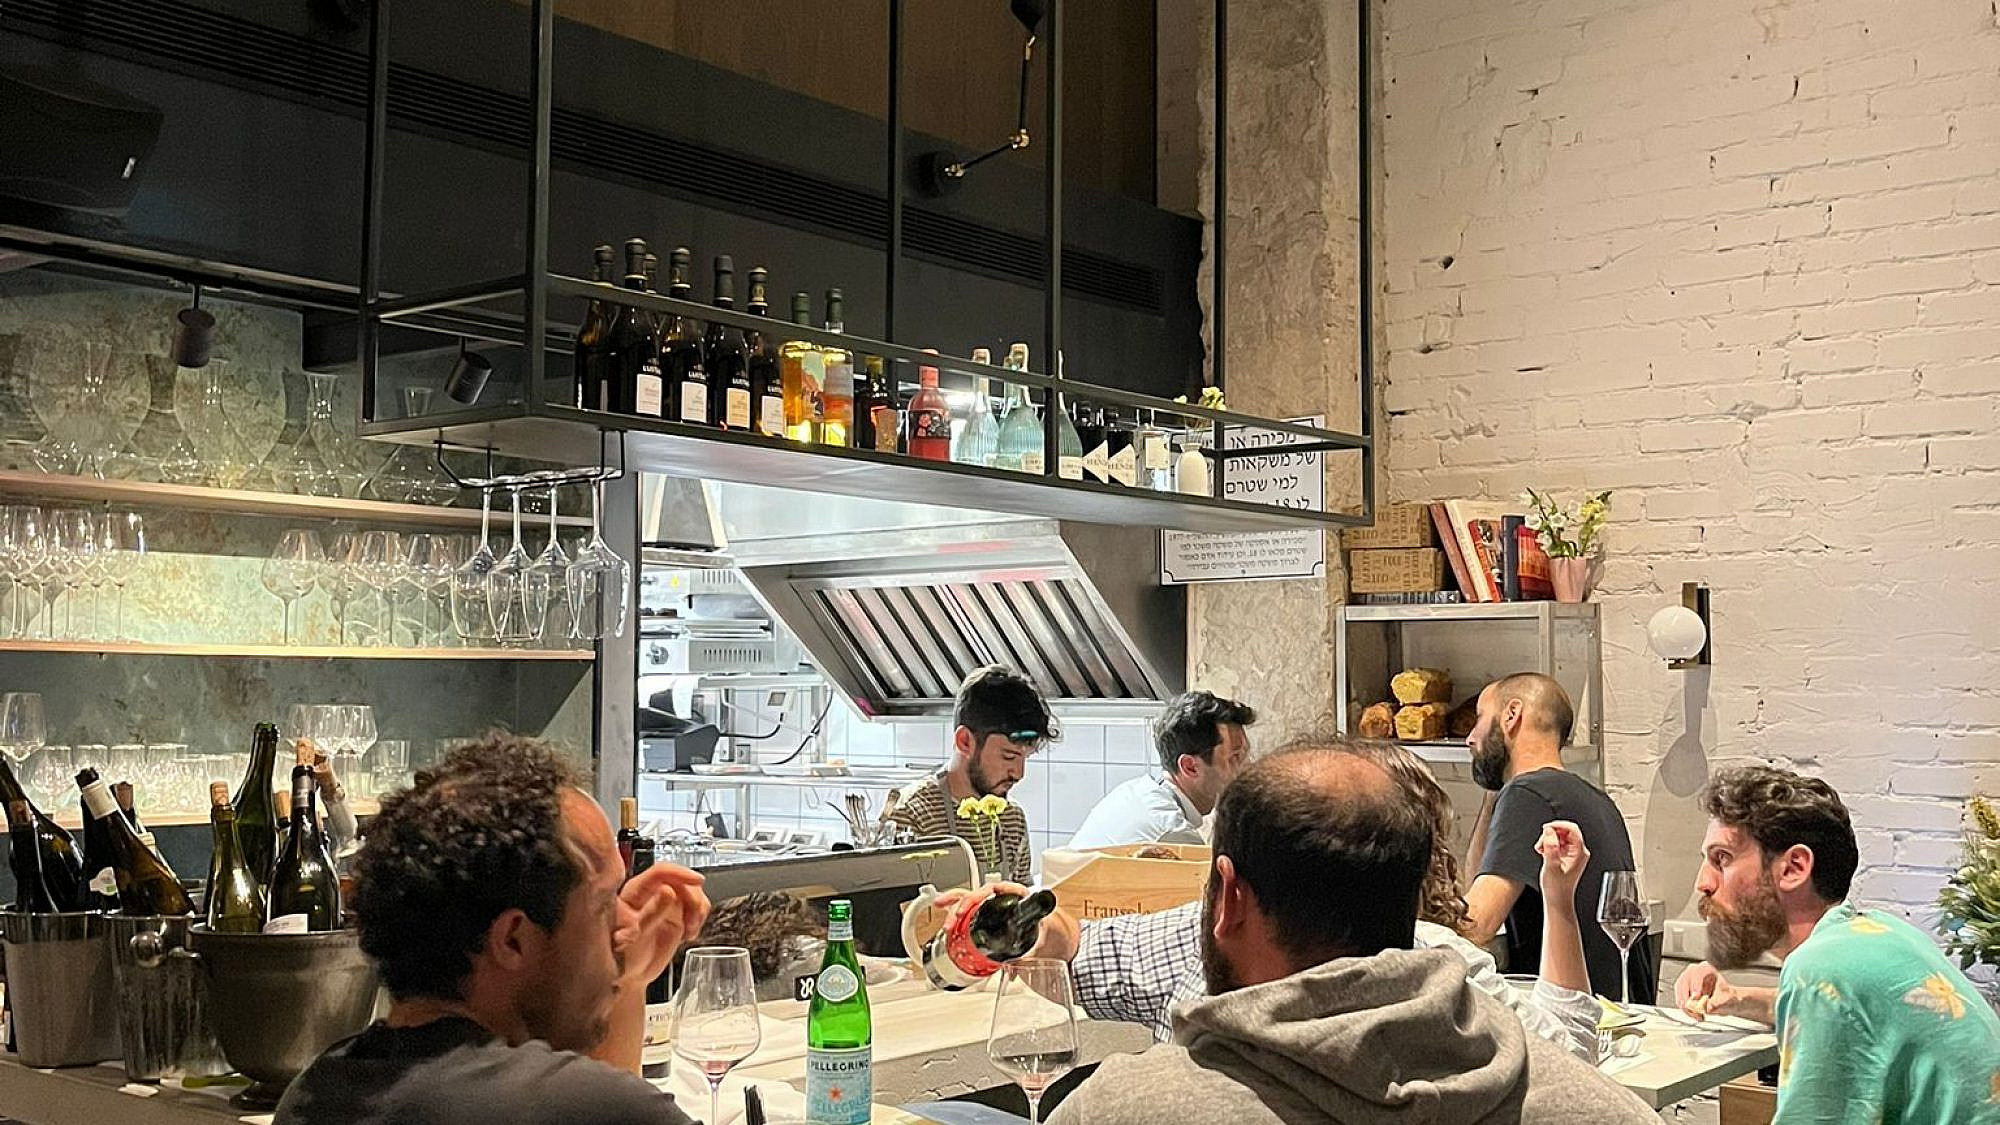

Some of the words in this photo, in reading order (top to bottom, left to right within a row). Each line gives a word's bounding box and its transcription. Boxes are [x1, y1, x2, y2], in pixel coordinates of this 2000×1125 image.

[1230, 436, 1246, 449] או
[1251, 431, 1296, 447] מכירה
[1229, 452, 1290, 472] משקאות
[1296, 451, 1316, 466] של
[1225, 479, 1268, 494] שטרם
[1272, 473, 1298, 489] למי
